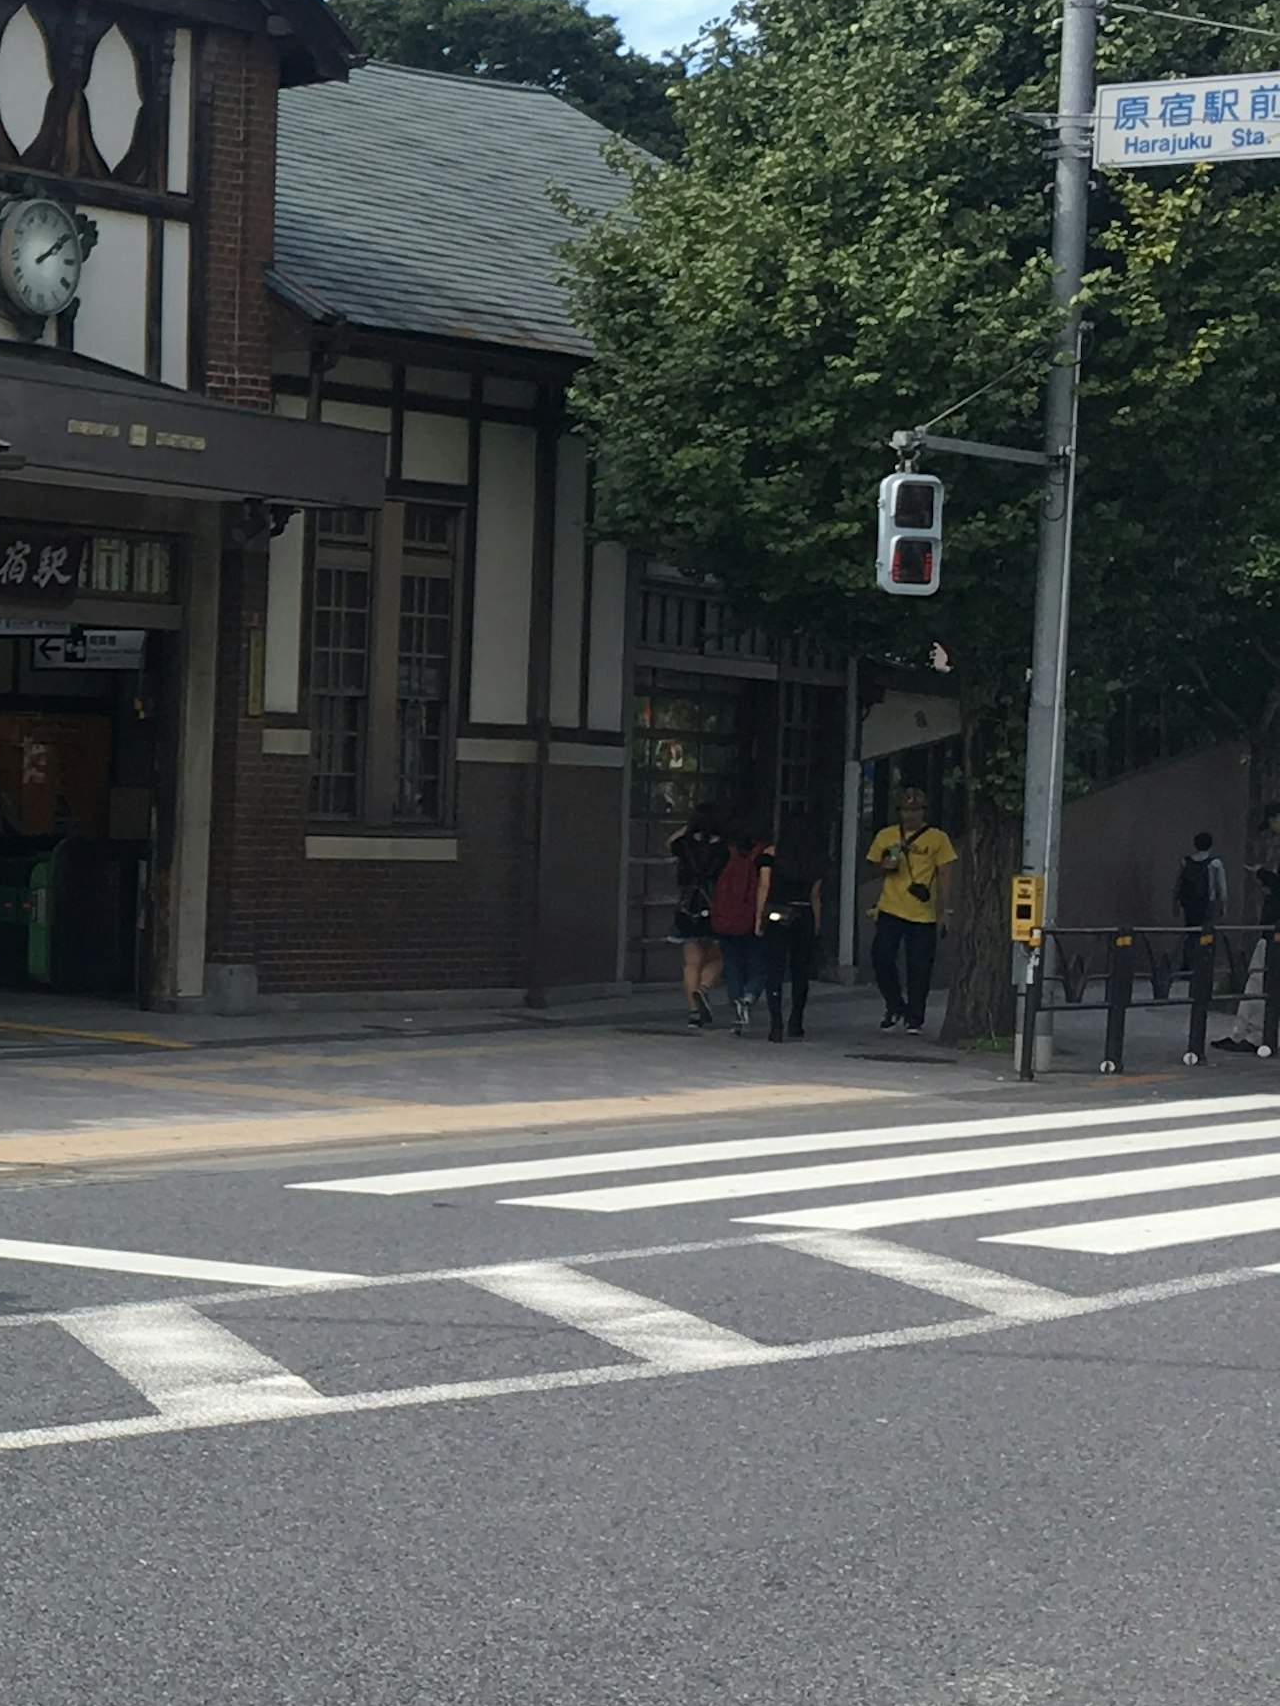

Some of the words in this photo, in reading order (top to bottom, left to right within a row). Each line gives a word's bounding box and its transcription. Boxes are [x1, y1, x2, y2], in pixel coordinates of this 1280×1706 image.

[1114, 85, 1280, 131] 原宿駅前
[1124, 131, 1212, 155] Harajuku
